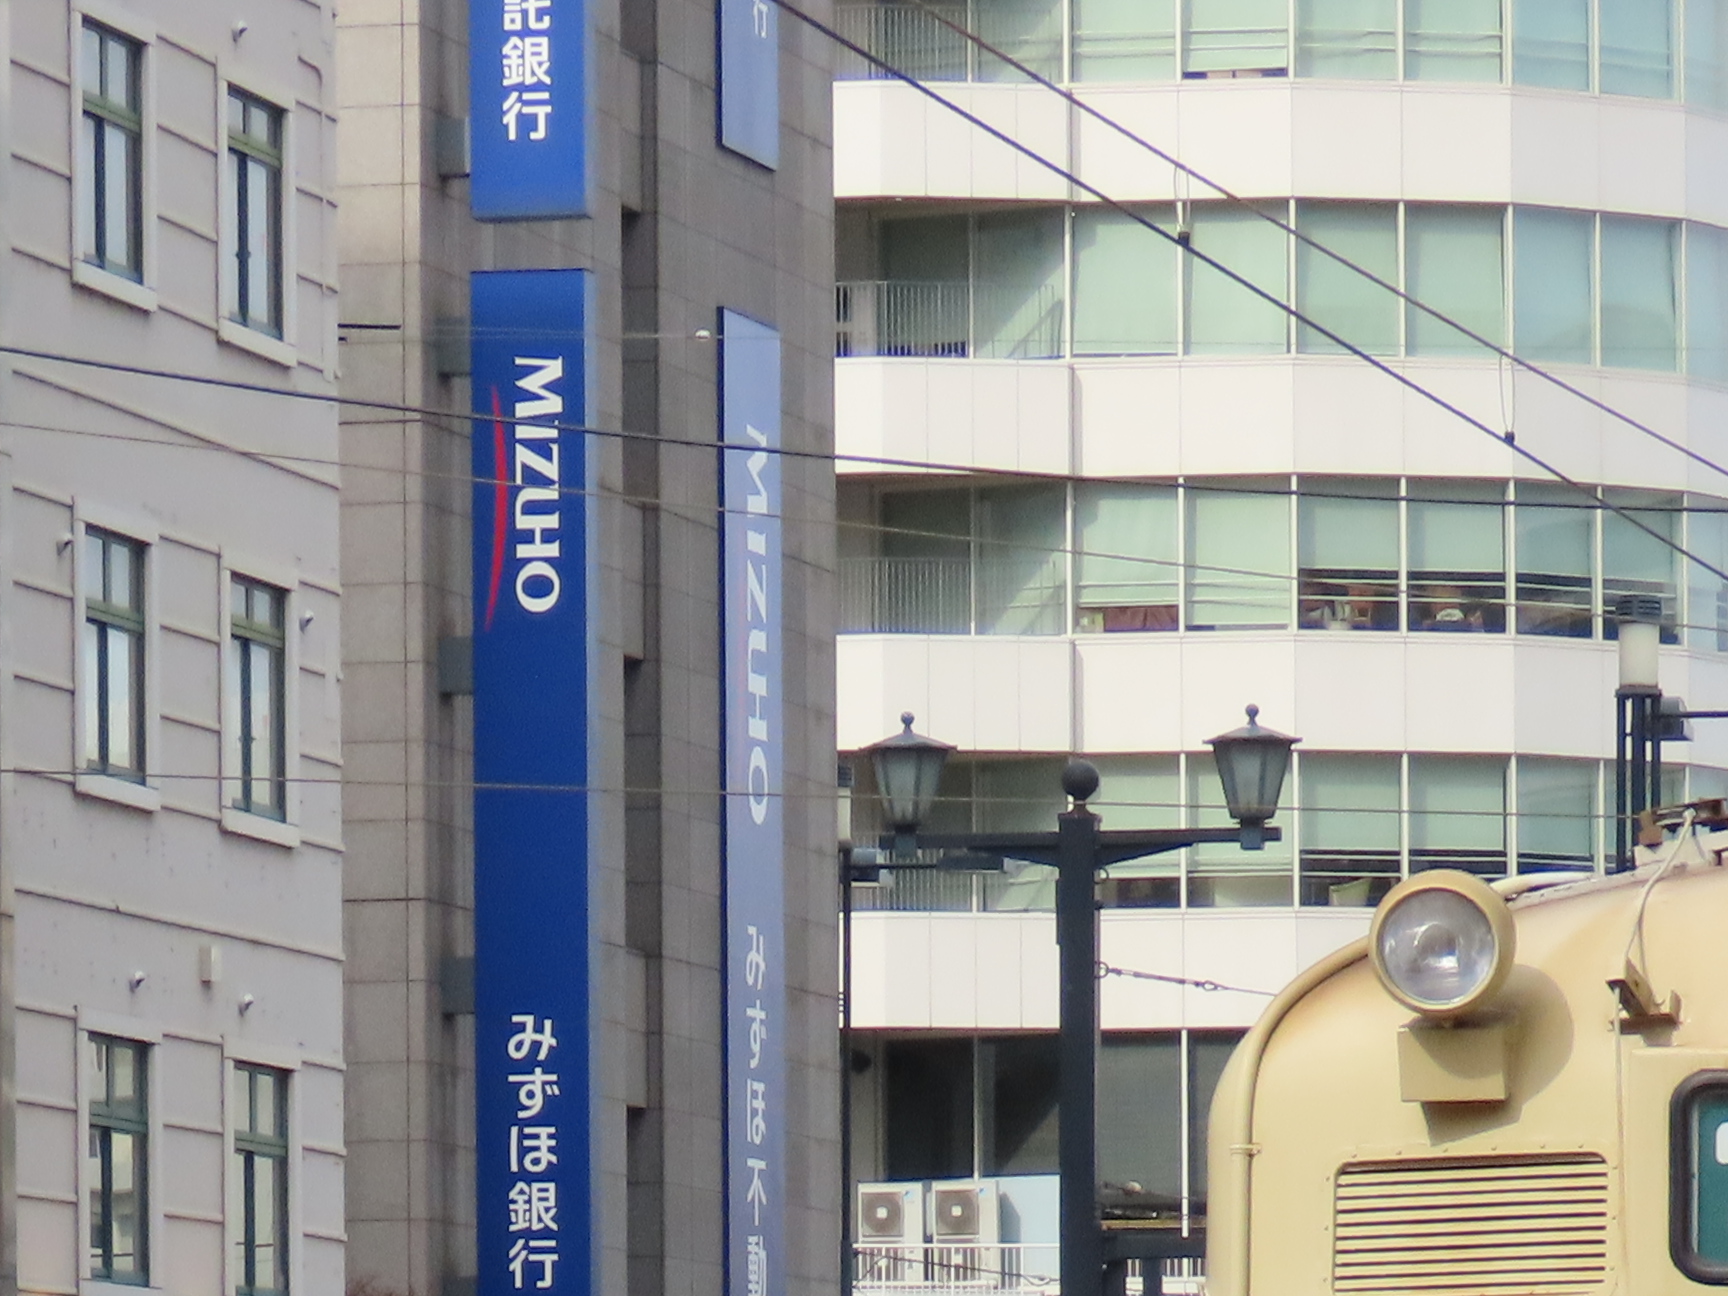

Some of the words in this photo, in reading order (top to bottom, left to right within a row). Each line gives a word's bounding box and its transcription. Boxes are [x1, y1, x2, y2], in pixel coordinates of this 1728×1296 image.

[513, 354, 565, 614] MIZUHO
[745, 423, 770, 826] MIZUHO
[506, 1012, 561, 1291] みずほ銀行
